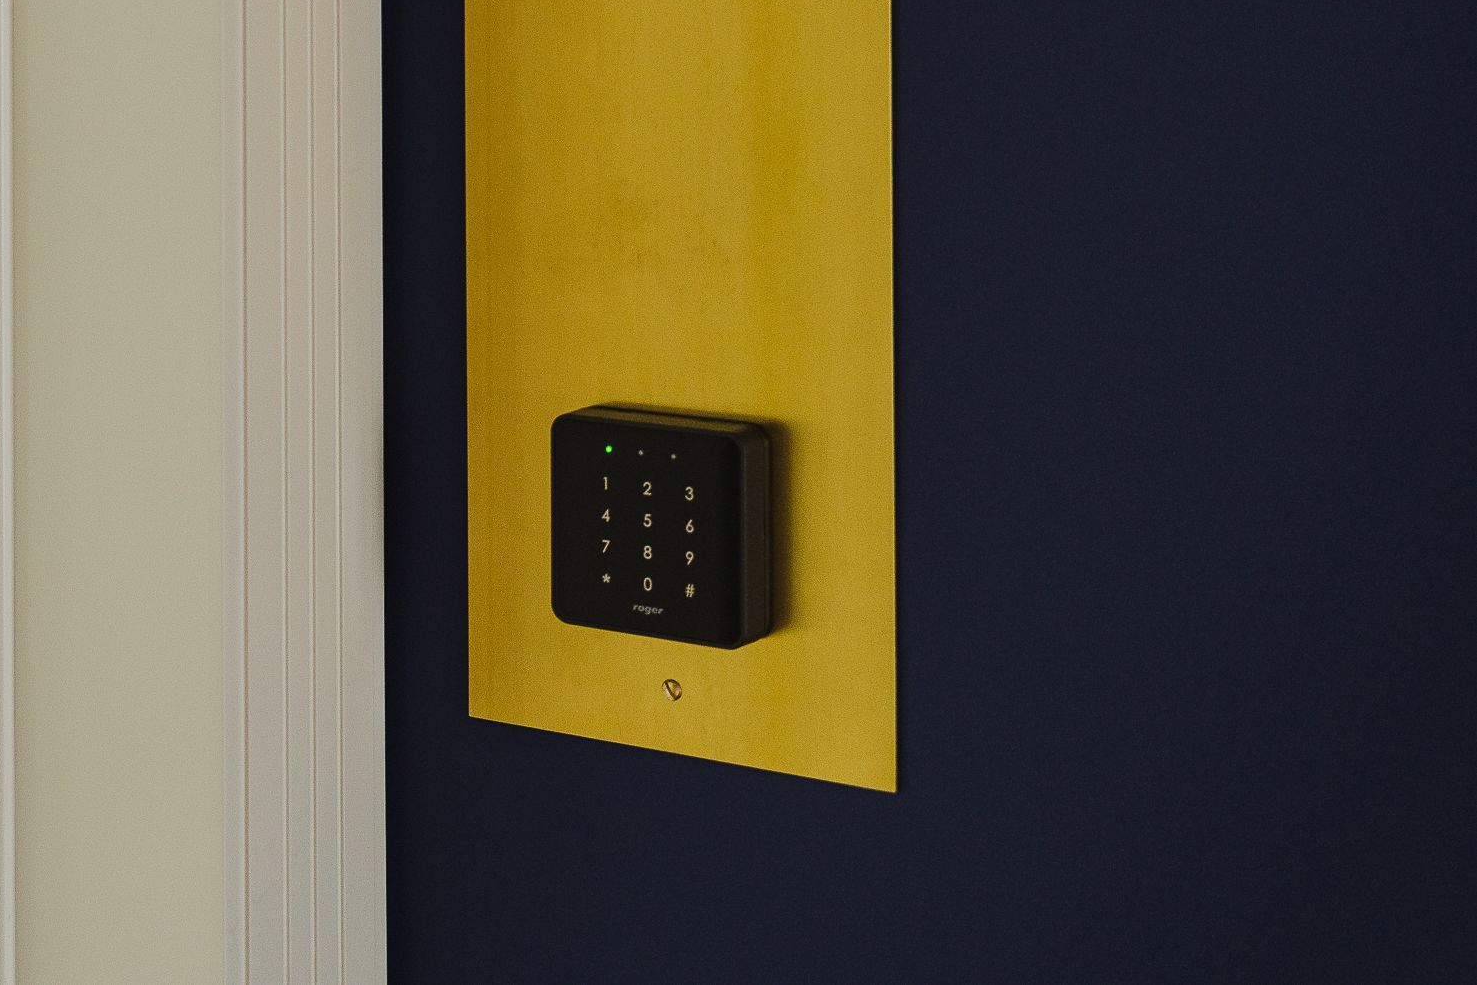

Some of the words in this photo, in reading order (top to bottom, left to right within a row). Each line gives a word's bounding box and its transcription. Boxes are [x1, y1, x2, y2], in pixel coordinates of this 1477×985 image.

[602, 476, 609, 490] 1
[642, 481, 652, 496] 2
[684, 486, 694, 501] 3
[601, 508, 611, 523] 4
[642, 513, 653, 528] 5
[685, 519, 695, 534] 6
[601, 539, 611, 554] 7
[642, 545, 653, 560] 8
[685, 550, 695, 566] 9
[642, 577, 653, 592] 0
[684, 583, 695, 598] #
[632, 602, 664, 615] roger
